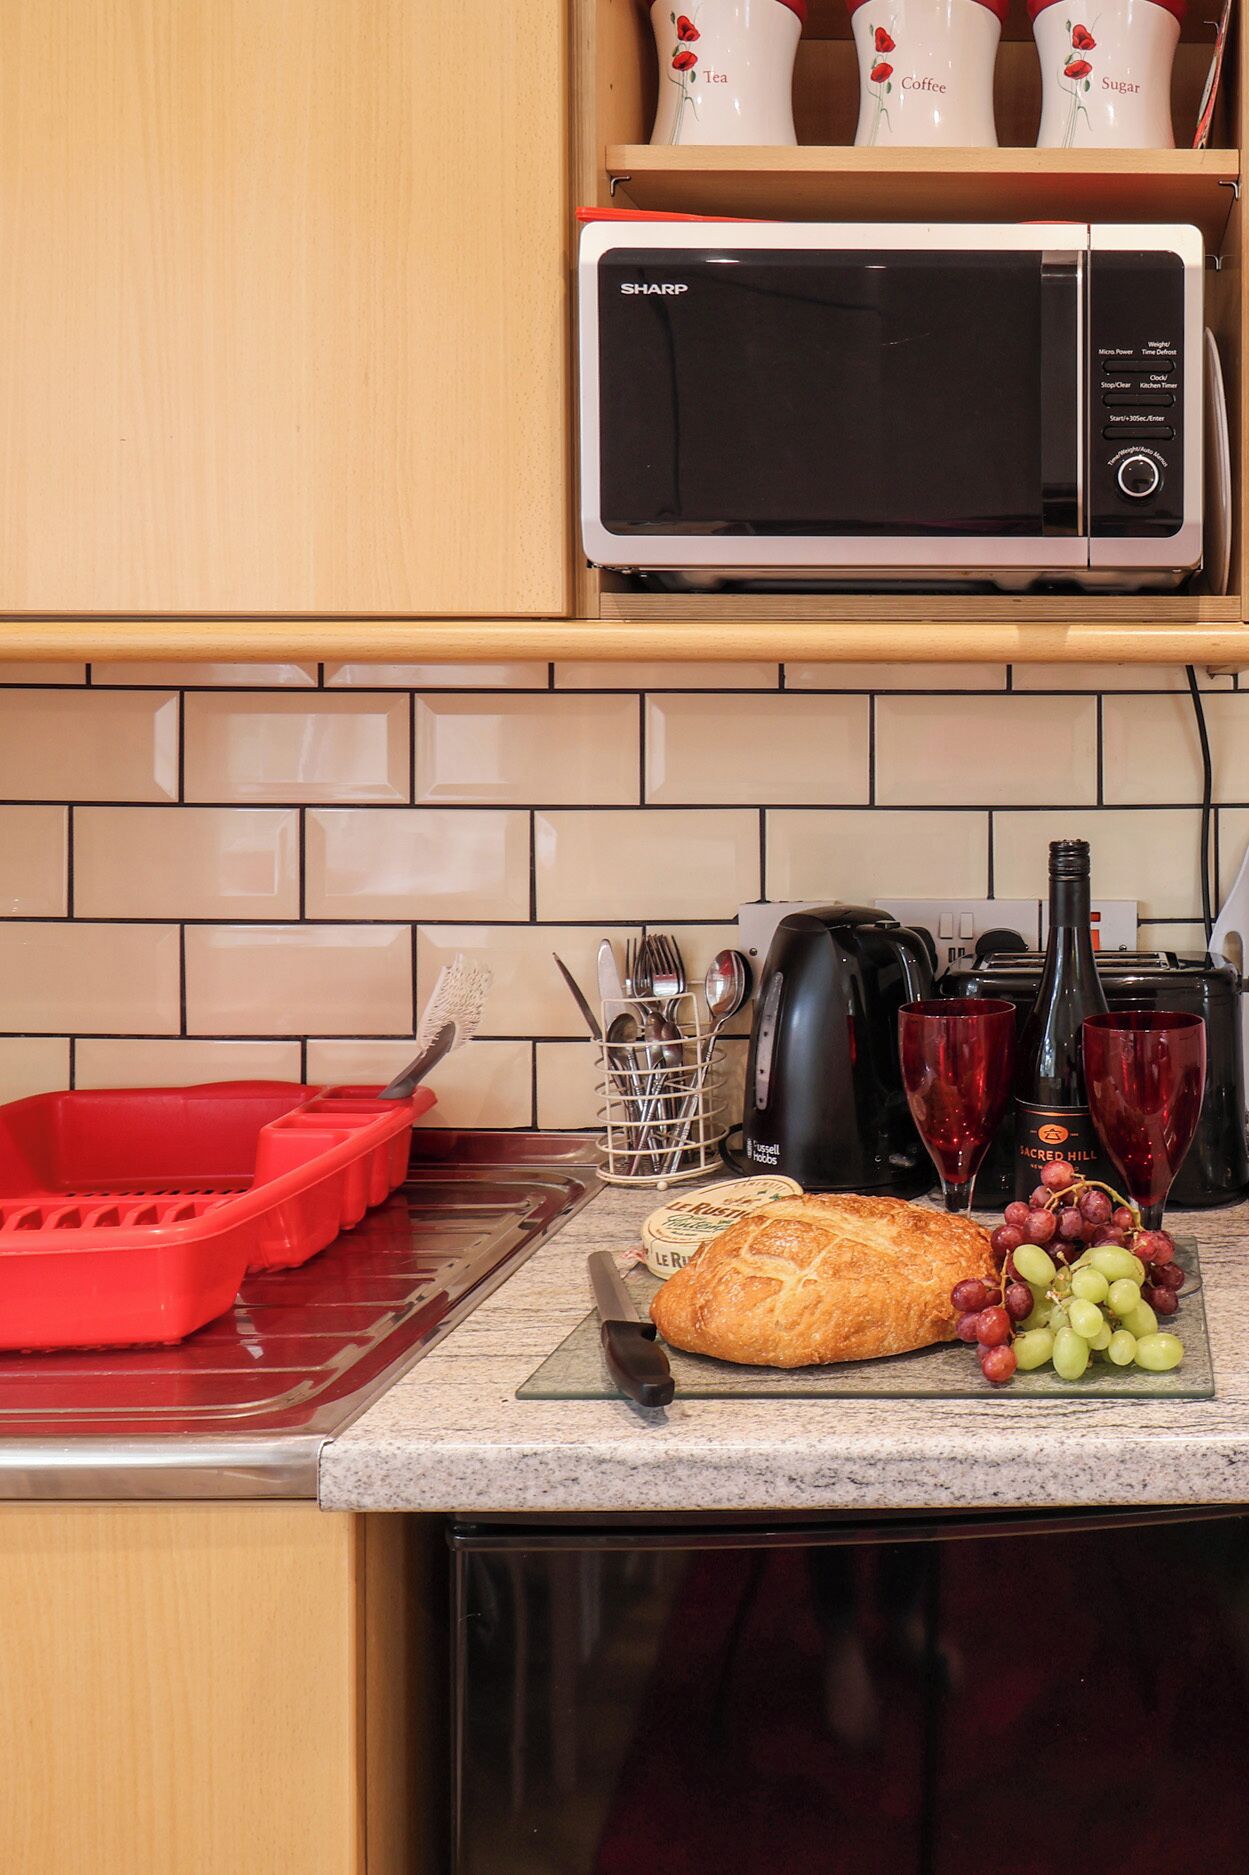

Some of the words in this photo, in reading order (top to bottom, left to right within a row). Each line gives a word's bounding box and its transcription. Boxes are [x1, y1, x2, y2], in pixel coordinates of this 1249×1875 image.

[703, 70, 728, 84] Tea
[901, 76, 947, 94] Coffee
[1101, 76, 1140, 94] Sugar
[620, 283, 689, 295] SHARP
[1100, 381, 1131, 389] Stop/Clear
[753, 1150, 777, 1165] Hobbs
[1020, 1145, 1064, 1161] SACRED
[1067, 1150, 1097, 1161] HILL
[665, 1201, 692, 1212] LE
[655, 1252, 669, 1267] LE
